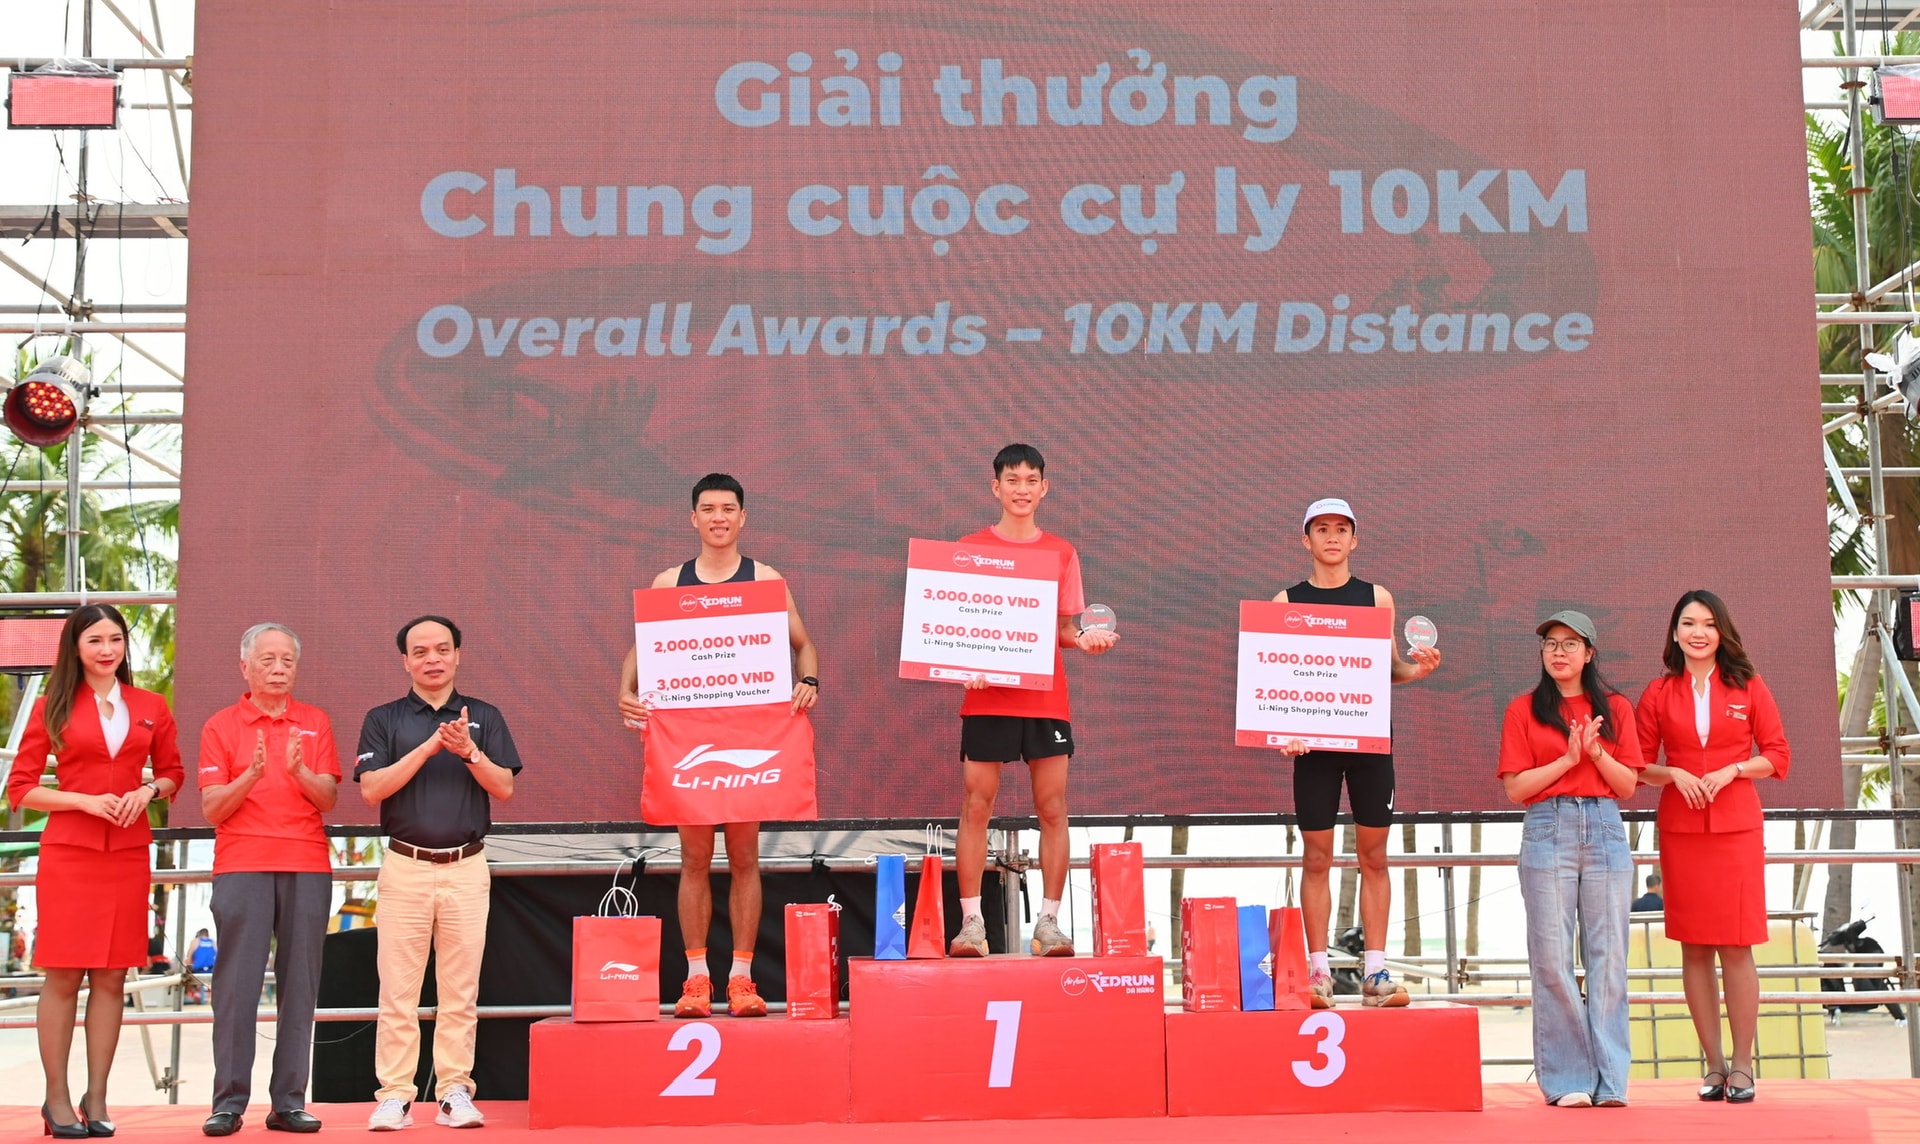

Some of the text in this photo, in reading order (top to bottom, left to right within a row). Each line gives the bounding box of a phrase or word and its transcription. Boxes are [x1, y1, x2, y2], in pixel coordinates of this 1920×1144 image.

[714, 48, 1298, 143] Giải thưởng
[420, 164, 1588, 256] Chung cuộc cự ly 10KM
[416, 301, 693, 358] Overall
[706, 301, 988, 356] Awards
[1063, 301, 1257, 355] 10KM
[1273, 294, 1594, 354] Distance
[970, 554, 1015, 567] REDRUN
[697, 595, 743, 609] REDRUN
[923, 588, 1040, 609] 3,000,000 VND
[958, 606, 1004, 616] Cash Prize
[1302, 614, 1347, 628] REDRUN
[921, 623, 1039, 643] 5,000,000 VND
[654, 633, 772, 653] 2,000,000 VND
[923, 638, 1033, 654] Li-Ning Shopping Voucher
[691, 651, 736, 661] Cash Prize
[1257, 651, 1372, 669] 1,000,000 VND
[656, 671, 775, 691] 3,000,000 VND
[1293, 669, 1338, 678] Cash Prize
[660, 693, 691, 702] Li-Ning
[693, 690, 734, 701] Shopping
[735, 688, 771, 698] Voucher
[1255, 687, 1373, 705] 2,000,000 VND
[1258, 705, 1369, 717] Li-Ning Shopping Voucher
[672, 768, 782, 790] LI-NING
[600, 973, 640, 981] LI-NING
[1087, 971, 1155, 993] REDRUN
[985, 1000, 1023, 1088] 1
[1291, 1011, 1347, 1087] 3
[658, 1022, 722, 1096] 2
